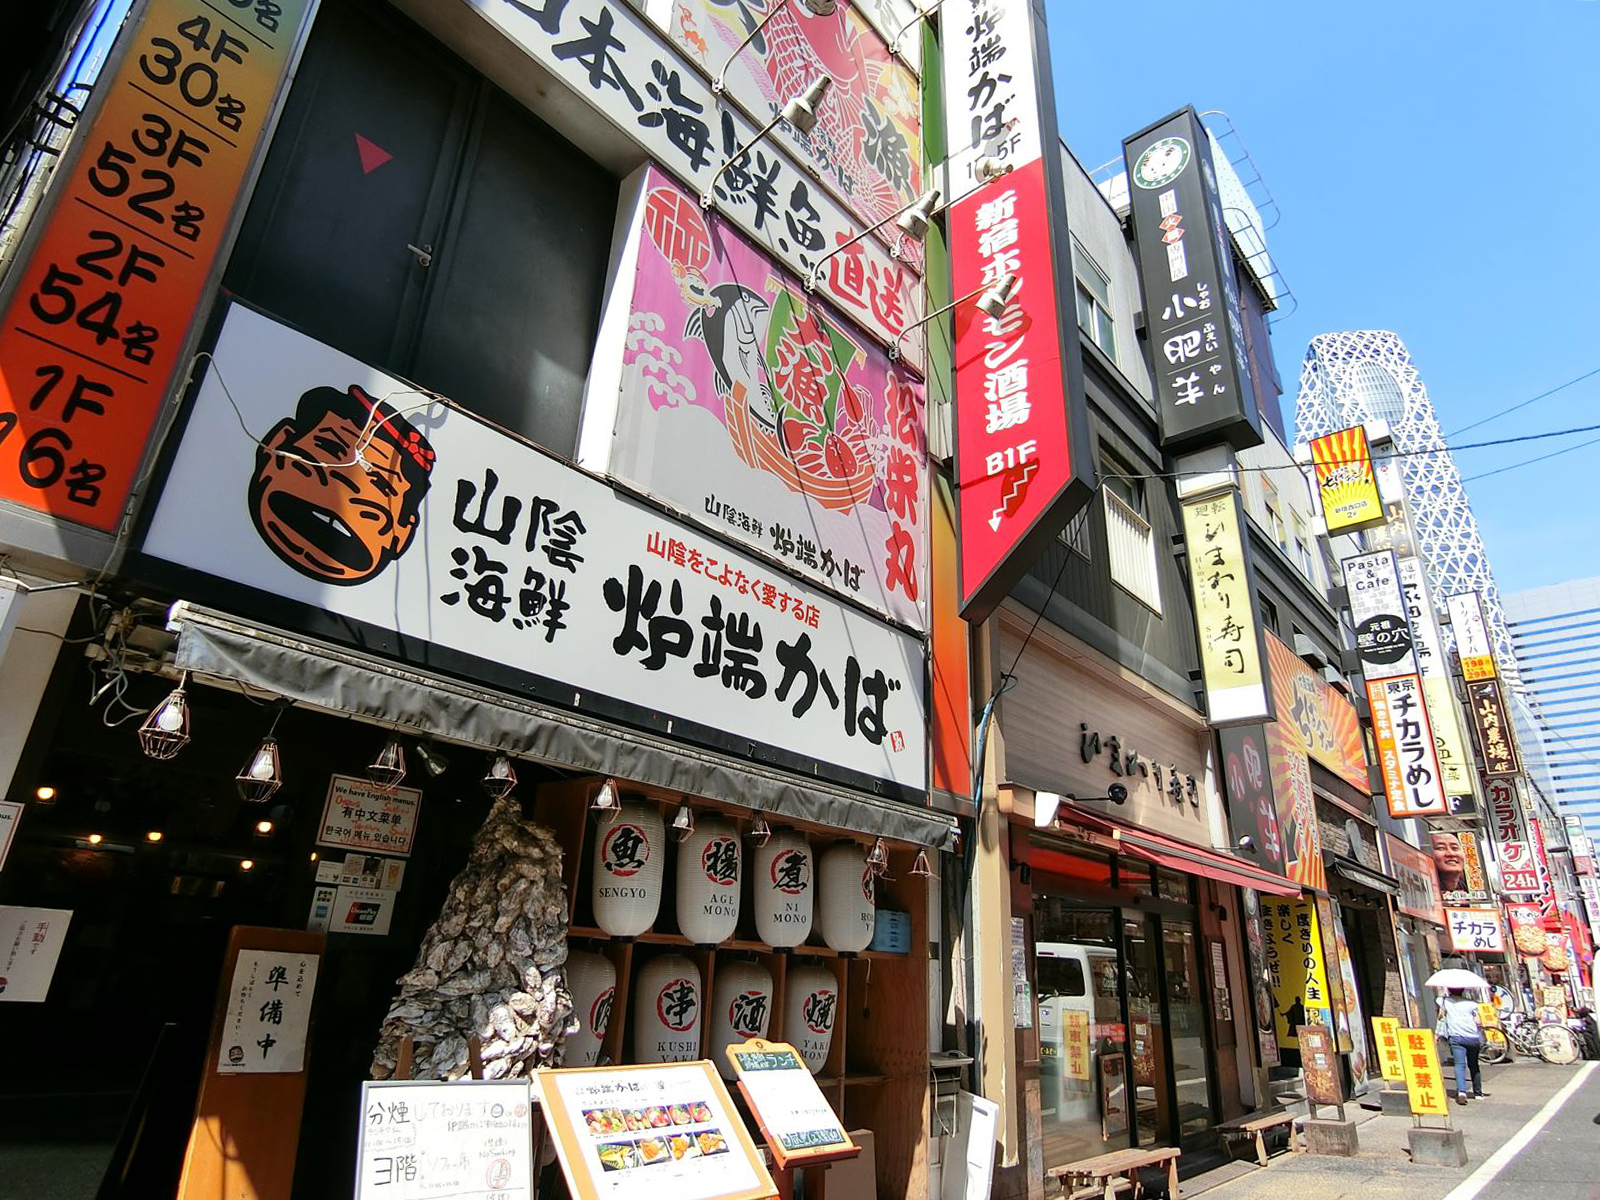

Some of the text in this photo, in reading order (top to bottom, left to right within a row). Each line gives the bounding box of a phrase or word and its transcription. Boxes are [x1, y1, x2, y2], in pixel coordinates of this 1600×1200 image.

[238, 0, 283, 33] 名
[177, 15, 249, 65] 4F
[139, 36, 247, 132] 30名
[966, 10, 1016, 149] 炉端かば
[132, 113, 210, 169] 3F
[88, 141, 206, 243] 52名
[76, 230, 165, 288] 2F
[30, 263, 160, 366] 54名
[975, 189, 1032, 436] 新宿ホモン酒場
[1161, 293, 1205, 406] 小肥羊
[30, 363, 114, 423] 1F
[985, 438, 1037, 478] B1F
[452, 467, 588, 573] 山陰
[704, 494, 866, 592] 山陰海鮮 炉端かば
[1348, 557, 1389, 571] Pasta
[440, 545, 572, 643] 海鮮
[646, 531, 821, 630] 山陰をこよなく愛する店
[1356, 577, 1389, 591] Cafe
[1366, 569, 1375, 579] &
[1204, 521, 1244, 674] ひまわり寿司
[602, 563, 902, 747] 炉端かば
[1357, 627, 1411, 648] 壁の穴
[1386, 679, 1416, 694] 東京
[1392, 692, 1435, 809] チカラめし
[335, 785, 348, 795] We
[348, 787, 365, 799] have
[367, 791, 392, 803] English
[325, 825, 352, 838] 한국어
[354, 830, 371, 841] 메뉴
[341, 806, 402, 826] 有中文菜单
[1490, 785, 1525, 862] カラオケ
[605, 827, 645, 871] 魚
[599, 885, 648, 899] SENGYO
[710, 892, 734, 905] AGE
[1504, 872, 1537, 889] 24h
[703, 904, 738, 918] MONO
[773, 912, 808, 925] MONO
[785, 902, 799, 913] NI
[1276, 903, 1295, 945] 楽しく
[1452, 921, 1497, 935] チカラ
[1294, 902, 1321, 1001] 一度きりの人生
[1473, 937, 1497, 949] めし
[256, 965, 289, 1060] 準備中
[733, 993, 766, 1033] 酒
[658, 1041, 697, 1053] KUSHI
[803, 1040, 829, 1050] YAKI
[1381, 1021, 1401, 1077] 駐車禁止
[1408, 1034, 1437, 1109] 駐車禁止
[367, 1101, 491, 1125] 分煙しております
